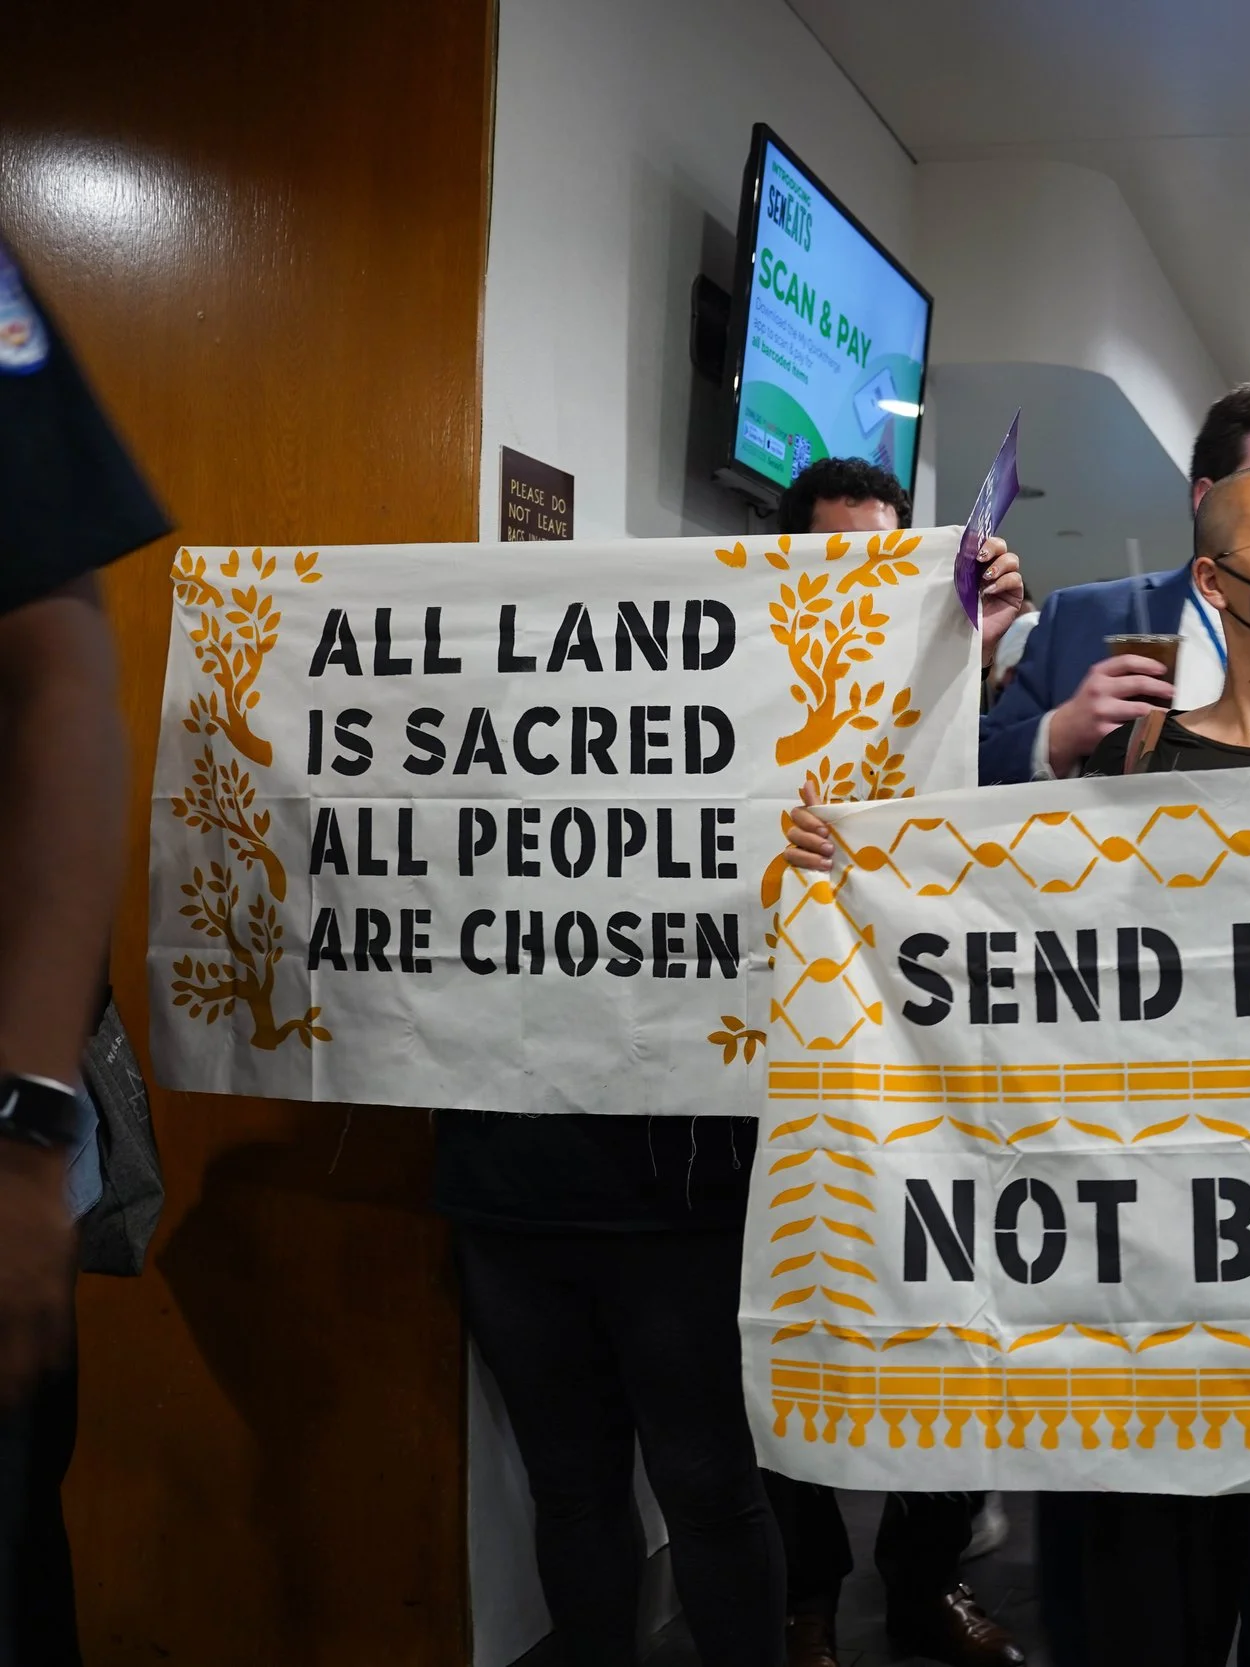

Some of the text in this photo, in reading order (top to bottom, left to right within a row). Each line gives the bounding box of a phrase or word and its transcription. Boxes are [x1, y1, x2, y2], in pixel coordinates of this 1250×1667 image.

[758, 247, 872, 369] SCAN & PAY
[508, 502, 568, 538] NOT LEAVE
[511, 479, 566, 514] PLEASE DO
[308, 599, 737, 677] ALL LAND
[307, 705, 737, 777] IS SACRED
[309, 806, 738, 880] ALL PEOPLE
[307, 907, 740, 981] ARE CHOSEN
[897, 926, 1184, 1027] SEND
[903, 1177, 1138, 1285] NOT
